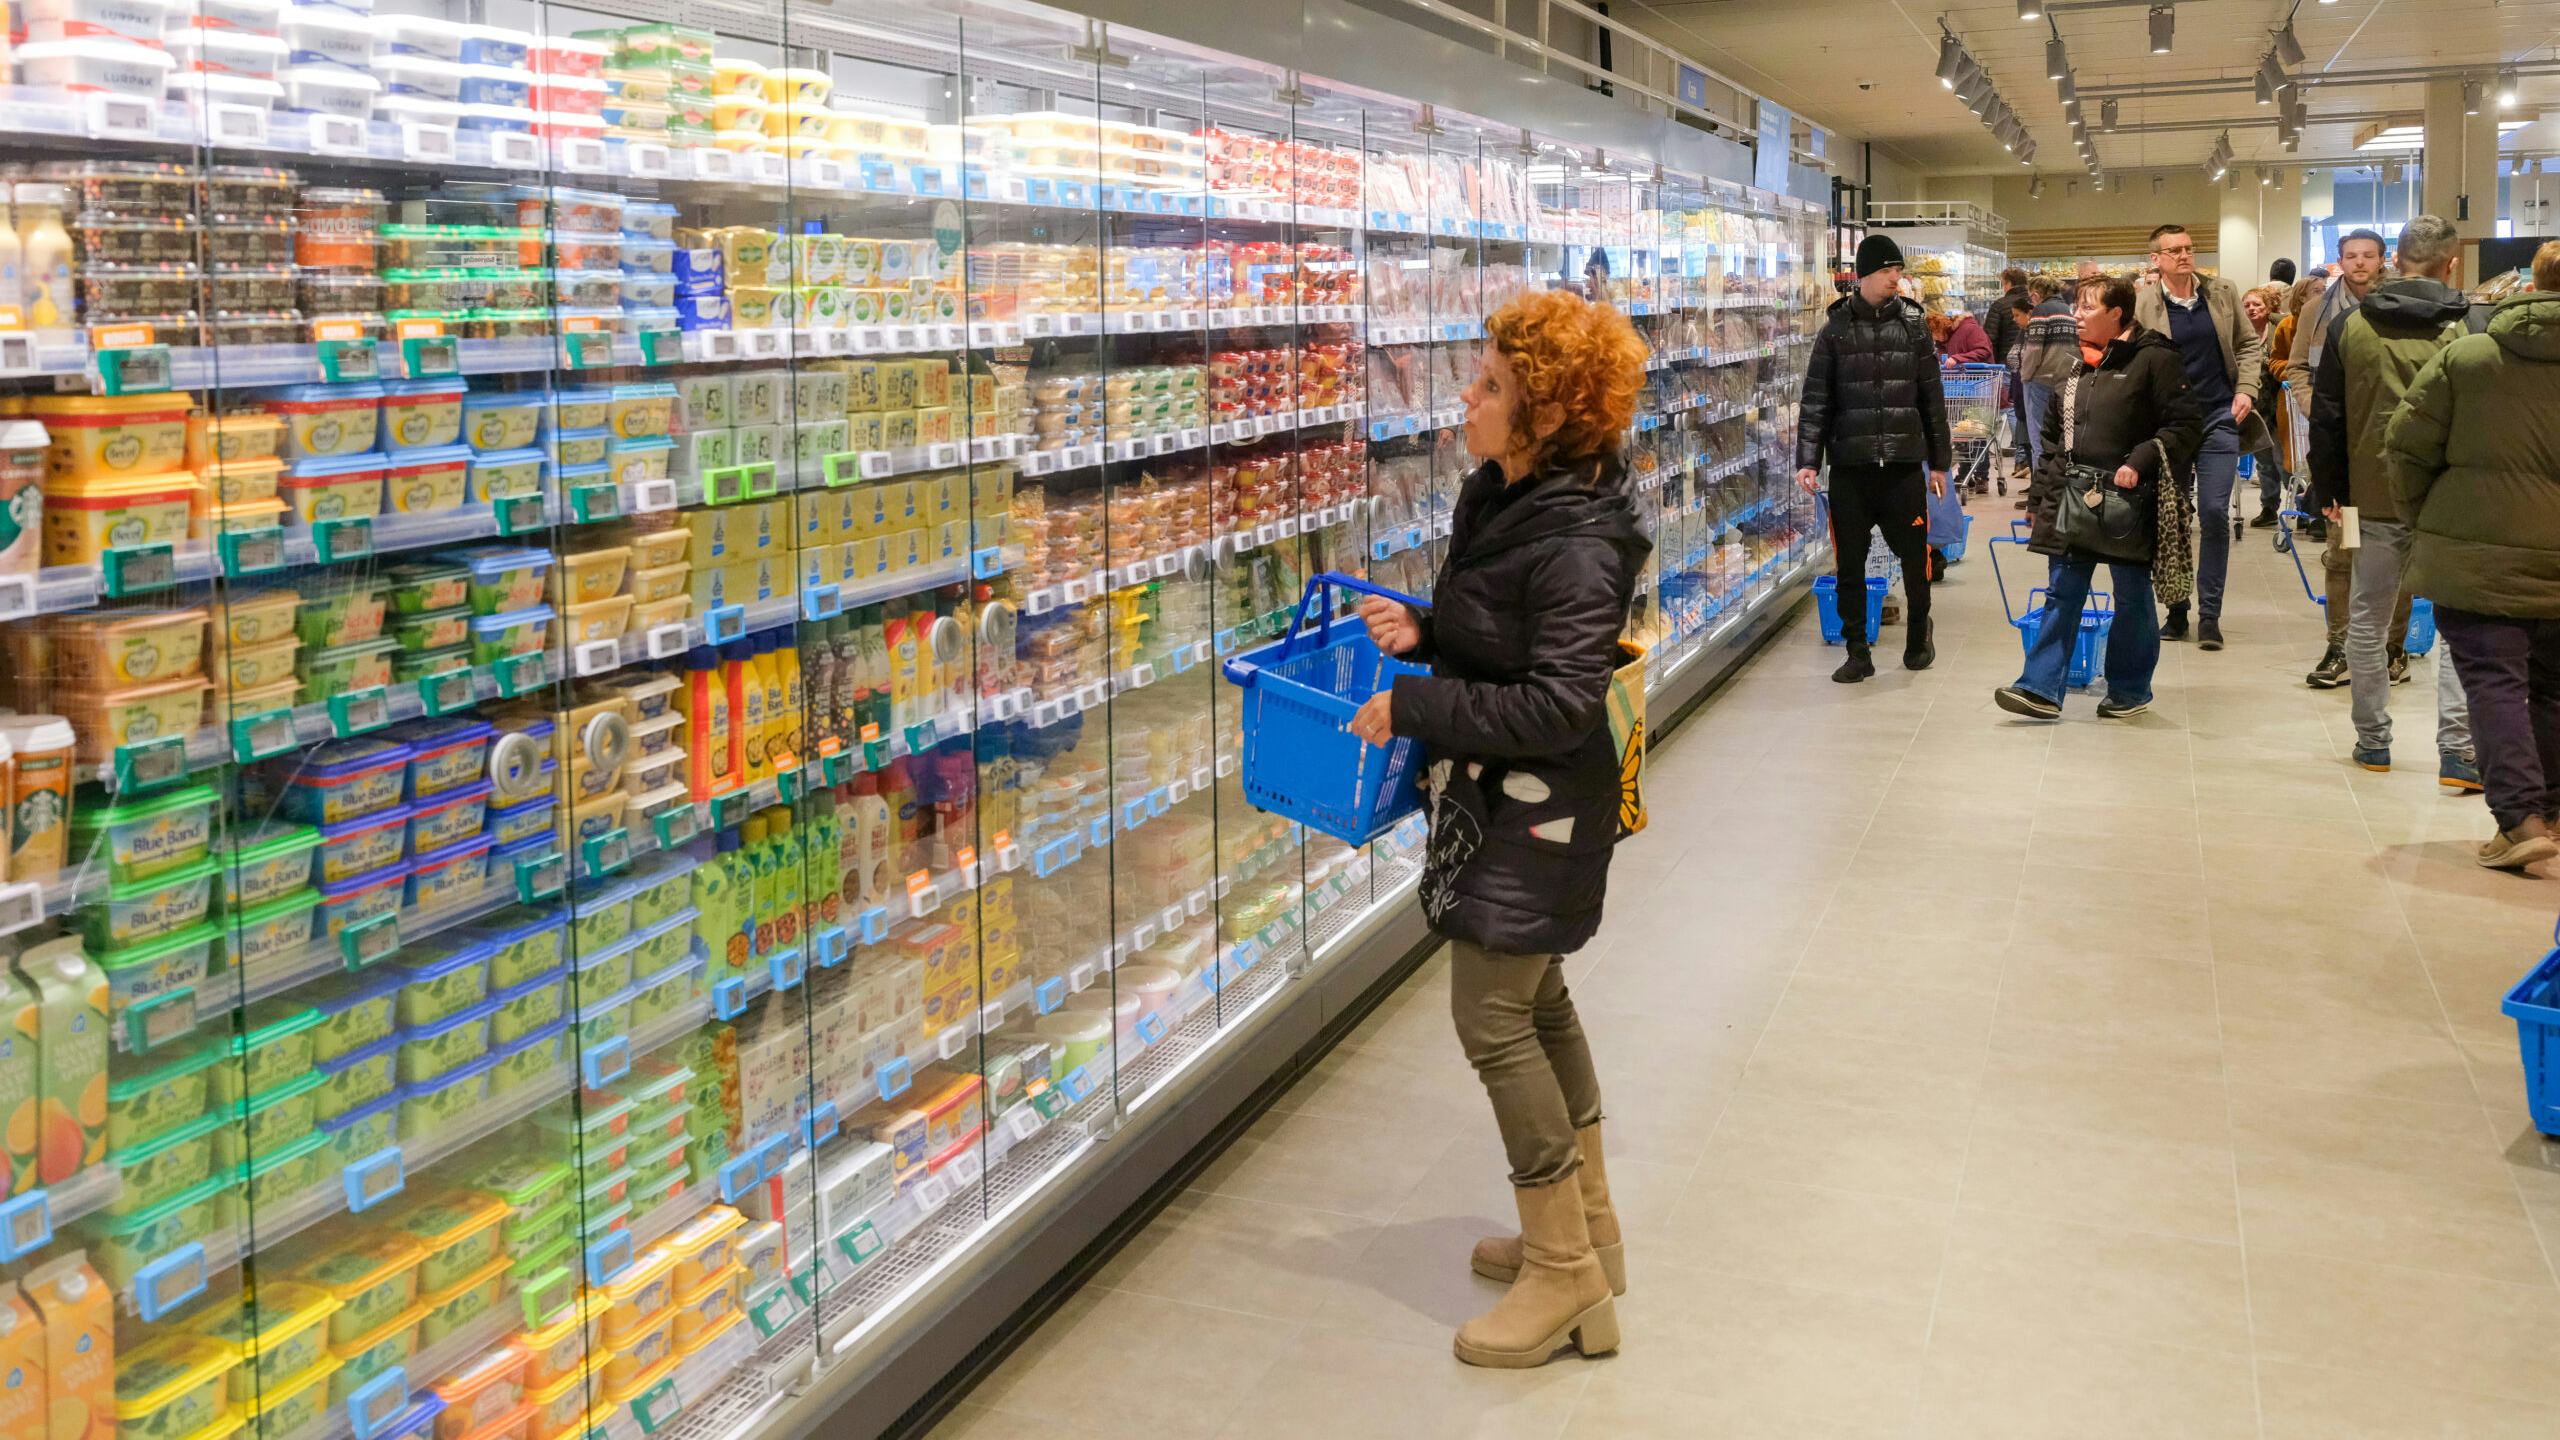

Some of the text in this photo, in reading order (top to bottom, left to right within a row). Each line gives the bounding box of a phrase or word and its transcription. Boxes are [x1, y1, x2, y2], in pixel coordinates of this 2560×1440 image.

[101, 10, 151, 25] LURPAK
[103, 71, 153, 88] LURPAK
[322, 95, 364, 109] LURPAK
[132, 823, 200, 853] Blue Band
[244, 863, 305, 895] Blue Band
[131, 897, 199, 929] Blue Band
[244, 927, 305, 956] Blue Band
[131, 963, 199, 998] Blue Band
